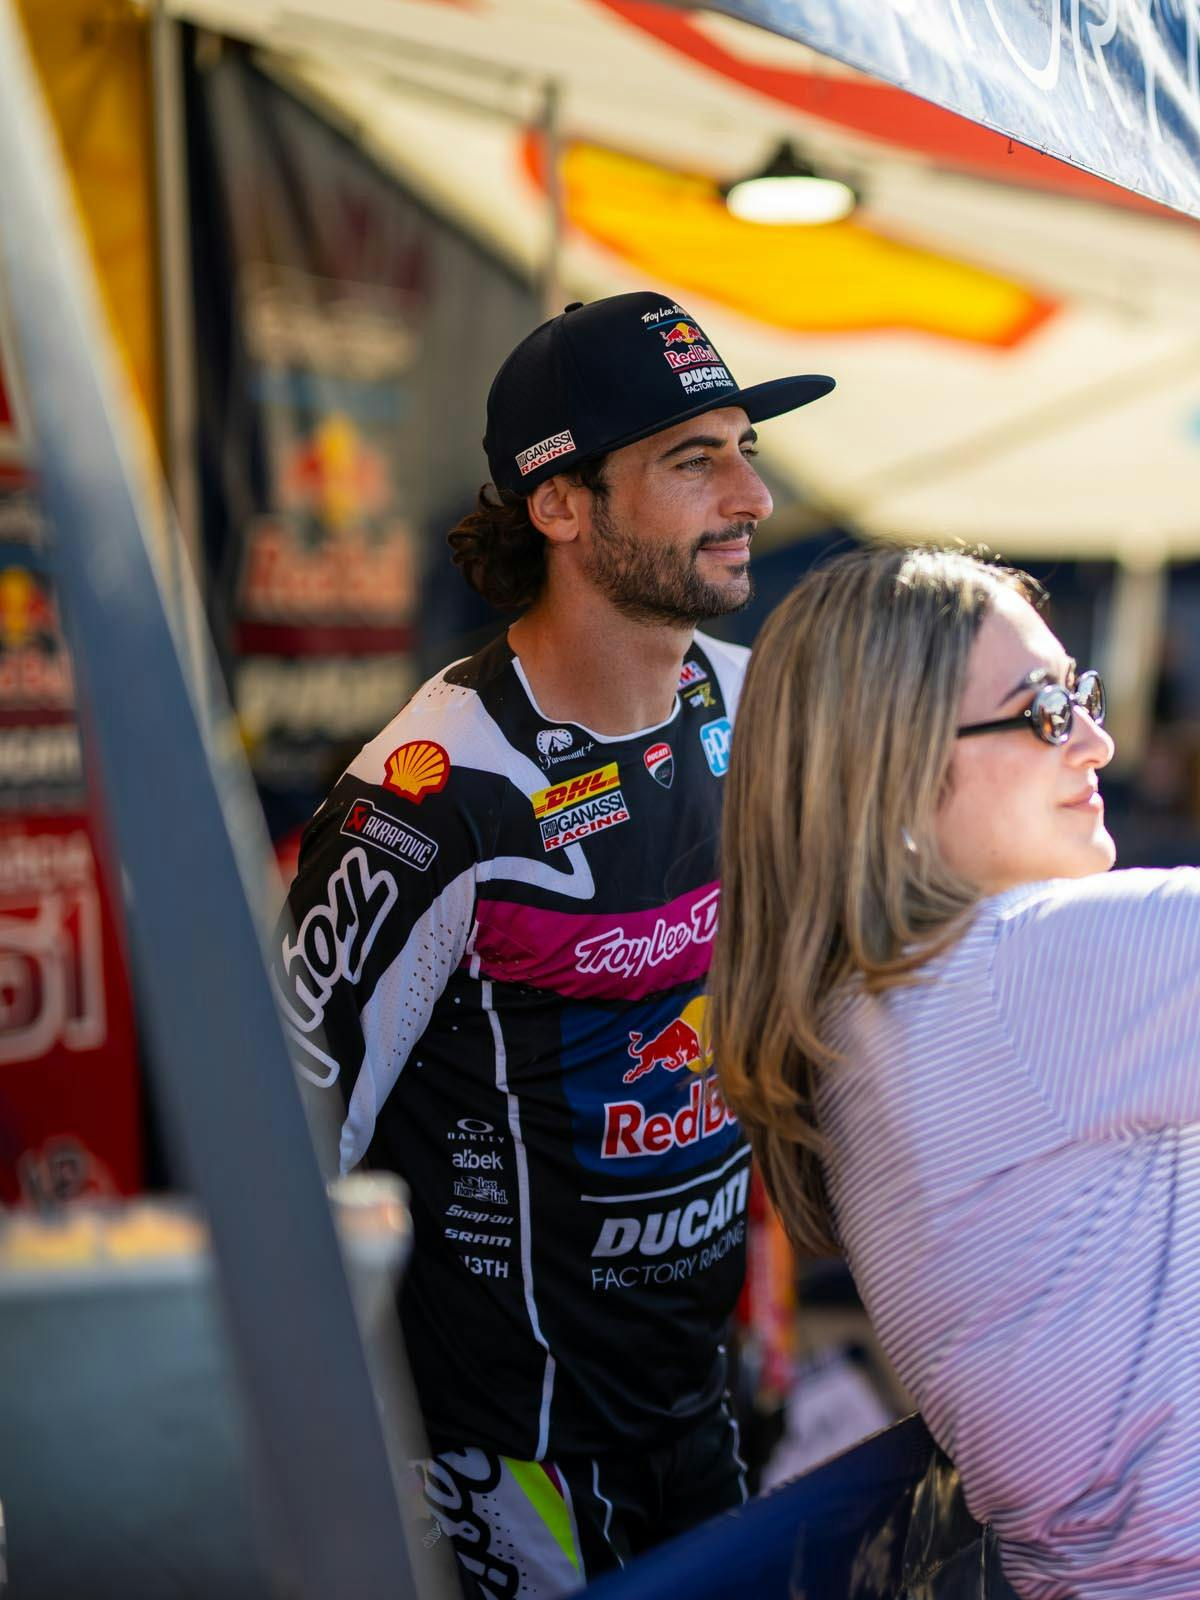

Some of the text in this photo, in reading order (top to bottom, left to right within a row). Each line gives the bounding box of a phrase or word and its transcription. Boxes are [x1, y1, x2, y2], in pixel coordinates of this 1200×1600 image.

[641, 311, 660, 323] Troy
[660, 307, 673, 317] Lee
[663, 344, 697, 369] Red
[679, 366, 729, 387] DUCATI
[520, 443, 575, 474] RACING
[525, 431, 572, 462] GANASSI
[544, 771, 607, 810] DHL
[544, 810, 628, 850] RACING
[558, 793, 625, 832] GANASSI
[574, 927, 651, 979] Troy
[648, 918, 692, 967] Lee
[600, 1080, 702, 1159] Red
[447, 1132, 504, 1143] OAKLEY
[591, 1167, 750, 1257] DUCATI
[444, 1227, 512, 1248] SRAM
[591, 1220, 746, 1291] FACTORY RACING
